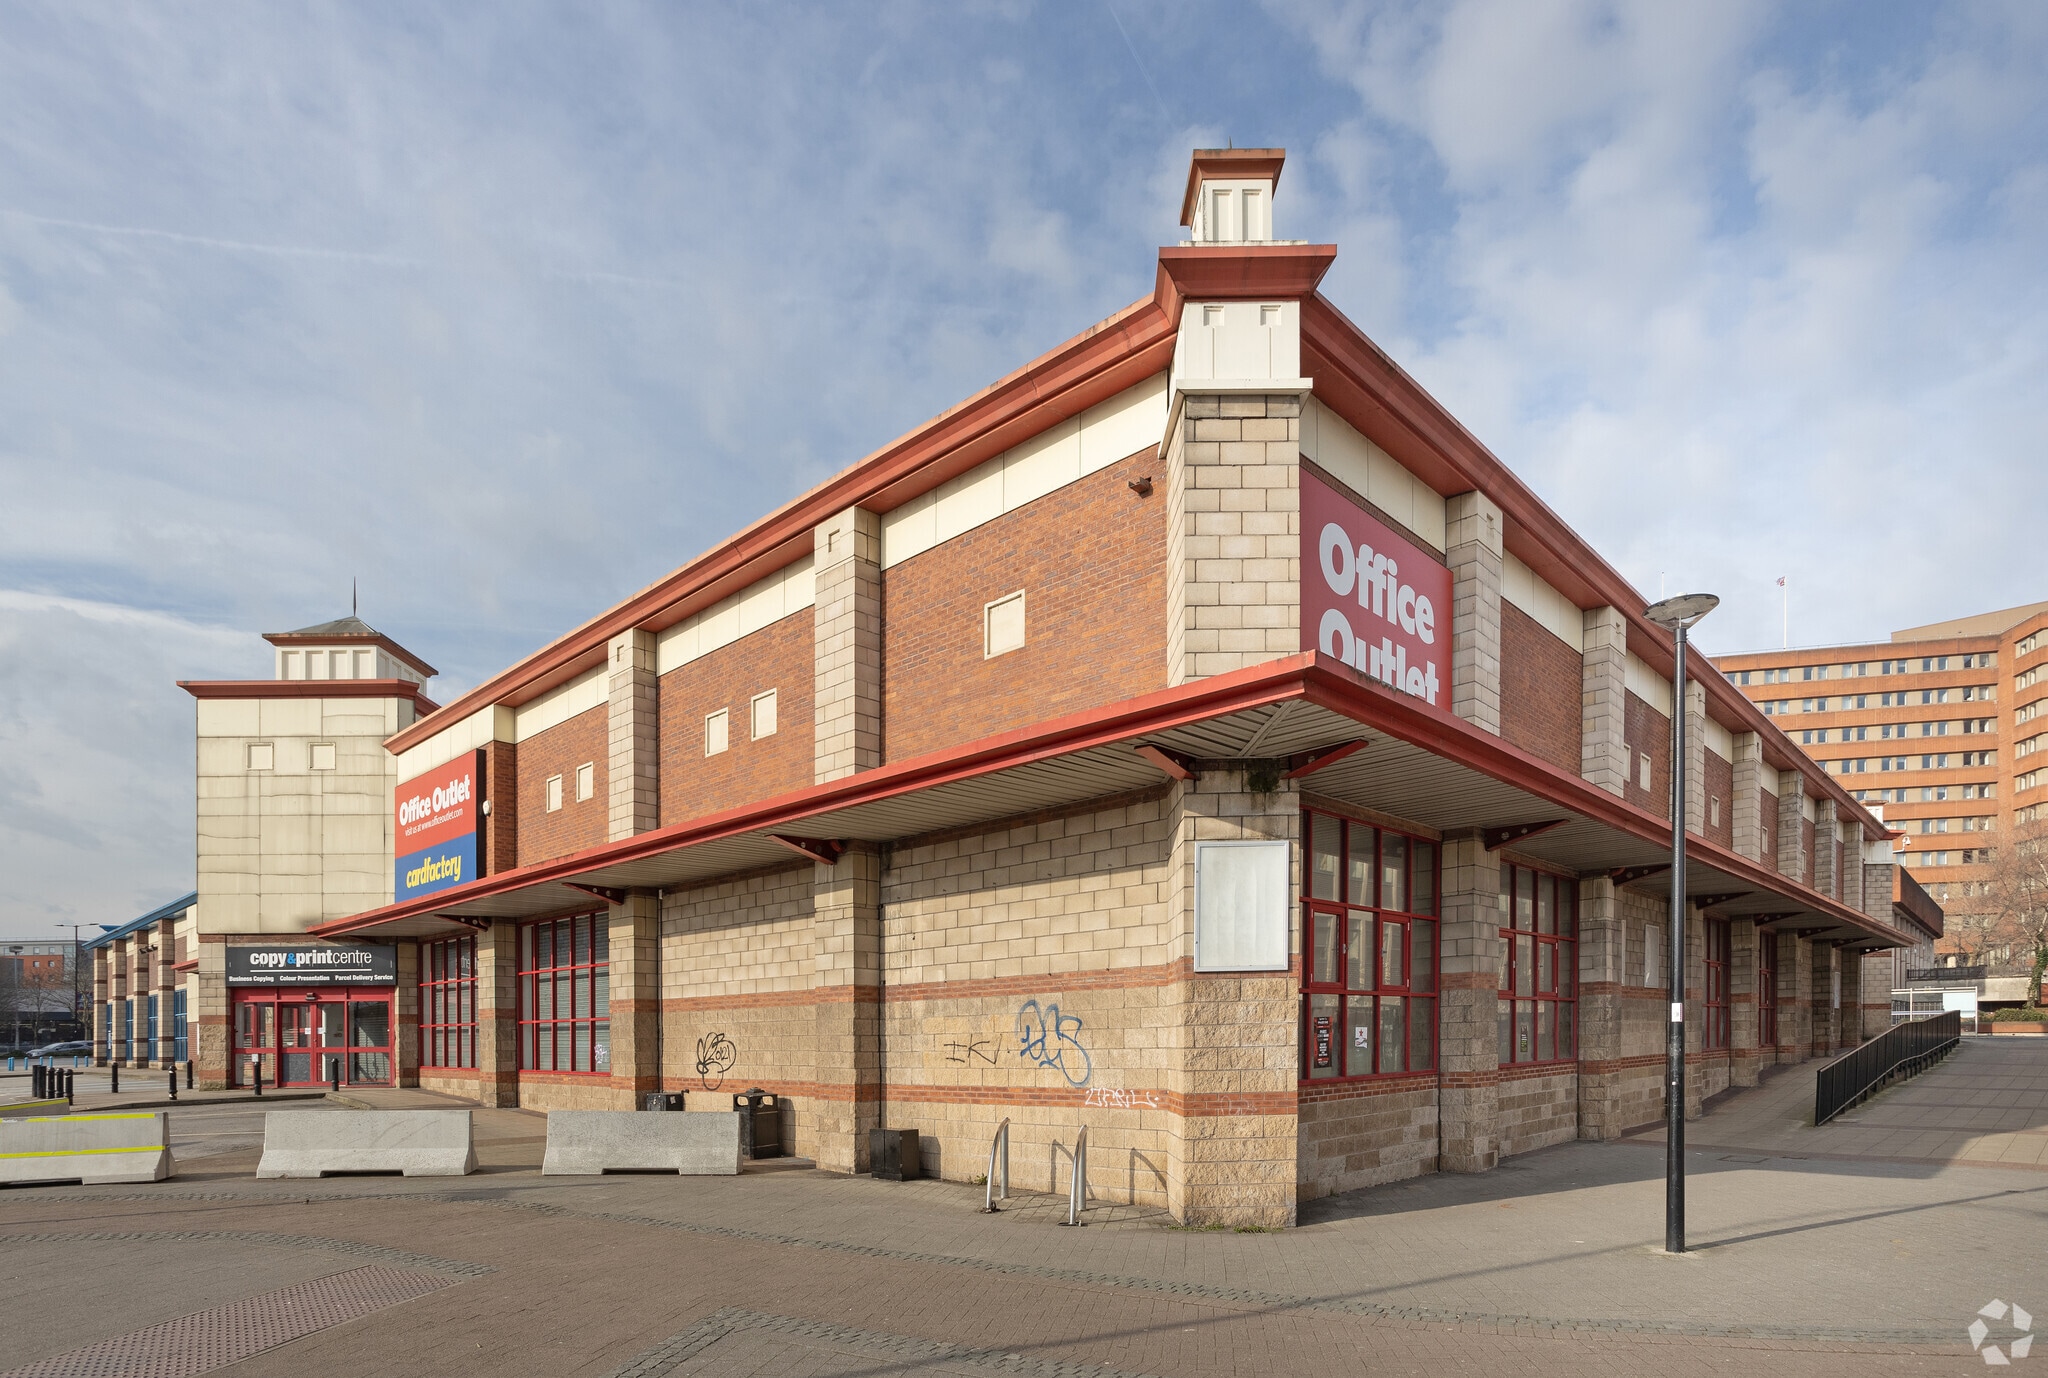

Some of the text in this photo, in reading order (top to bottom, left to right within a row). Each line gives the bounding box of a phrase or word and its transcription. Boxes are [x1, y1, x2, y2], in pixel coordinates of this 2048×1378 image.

[1319, 522, 1435, 645] Office
[1319, 608, 1439, 706] Outlet
[399, 774, 471, 826] Office Outlet
[405, 825, 413, 837] visit
[413, 824, 418, 834] us
[421, 808, 463, 830] www.officeoutlet.com
[406, 855, 462, 888] cardfactory
[253, 975, 274, 983] Copying
[352, 974, 373, 982] Delivery
